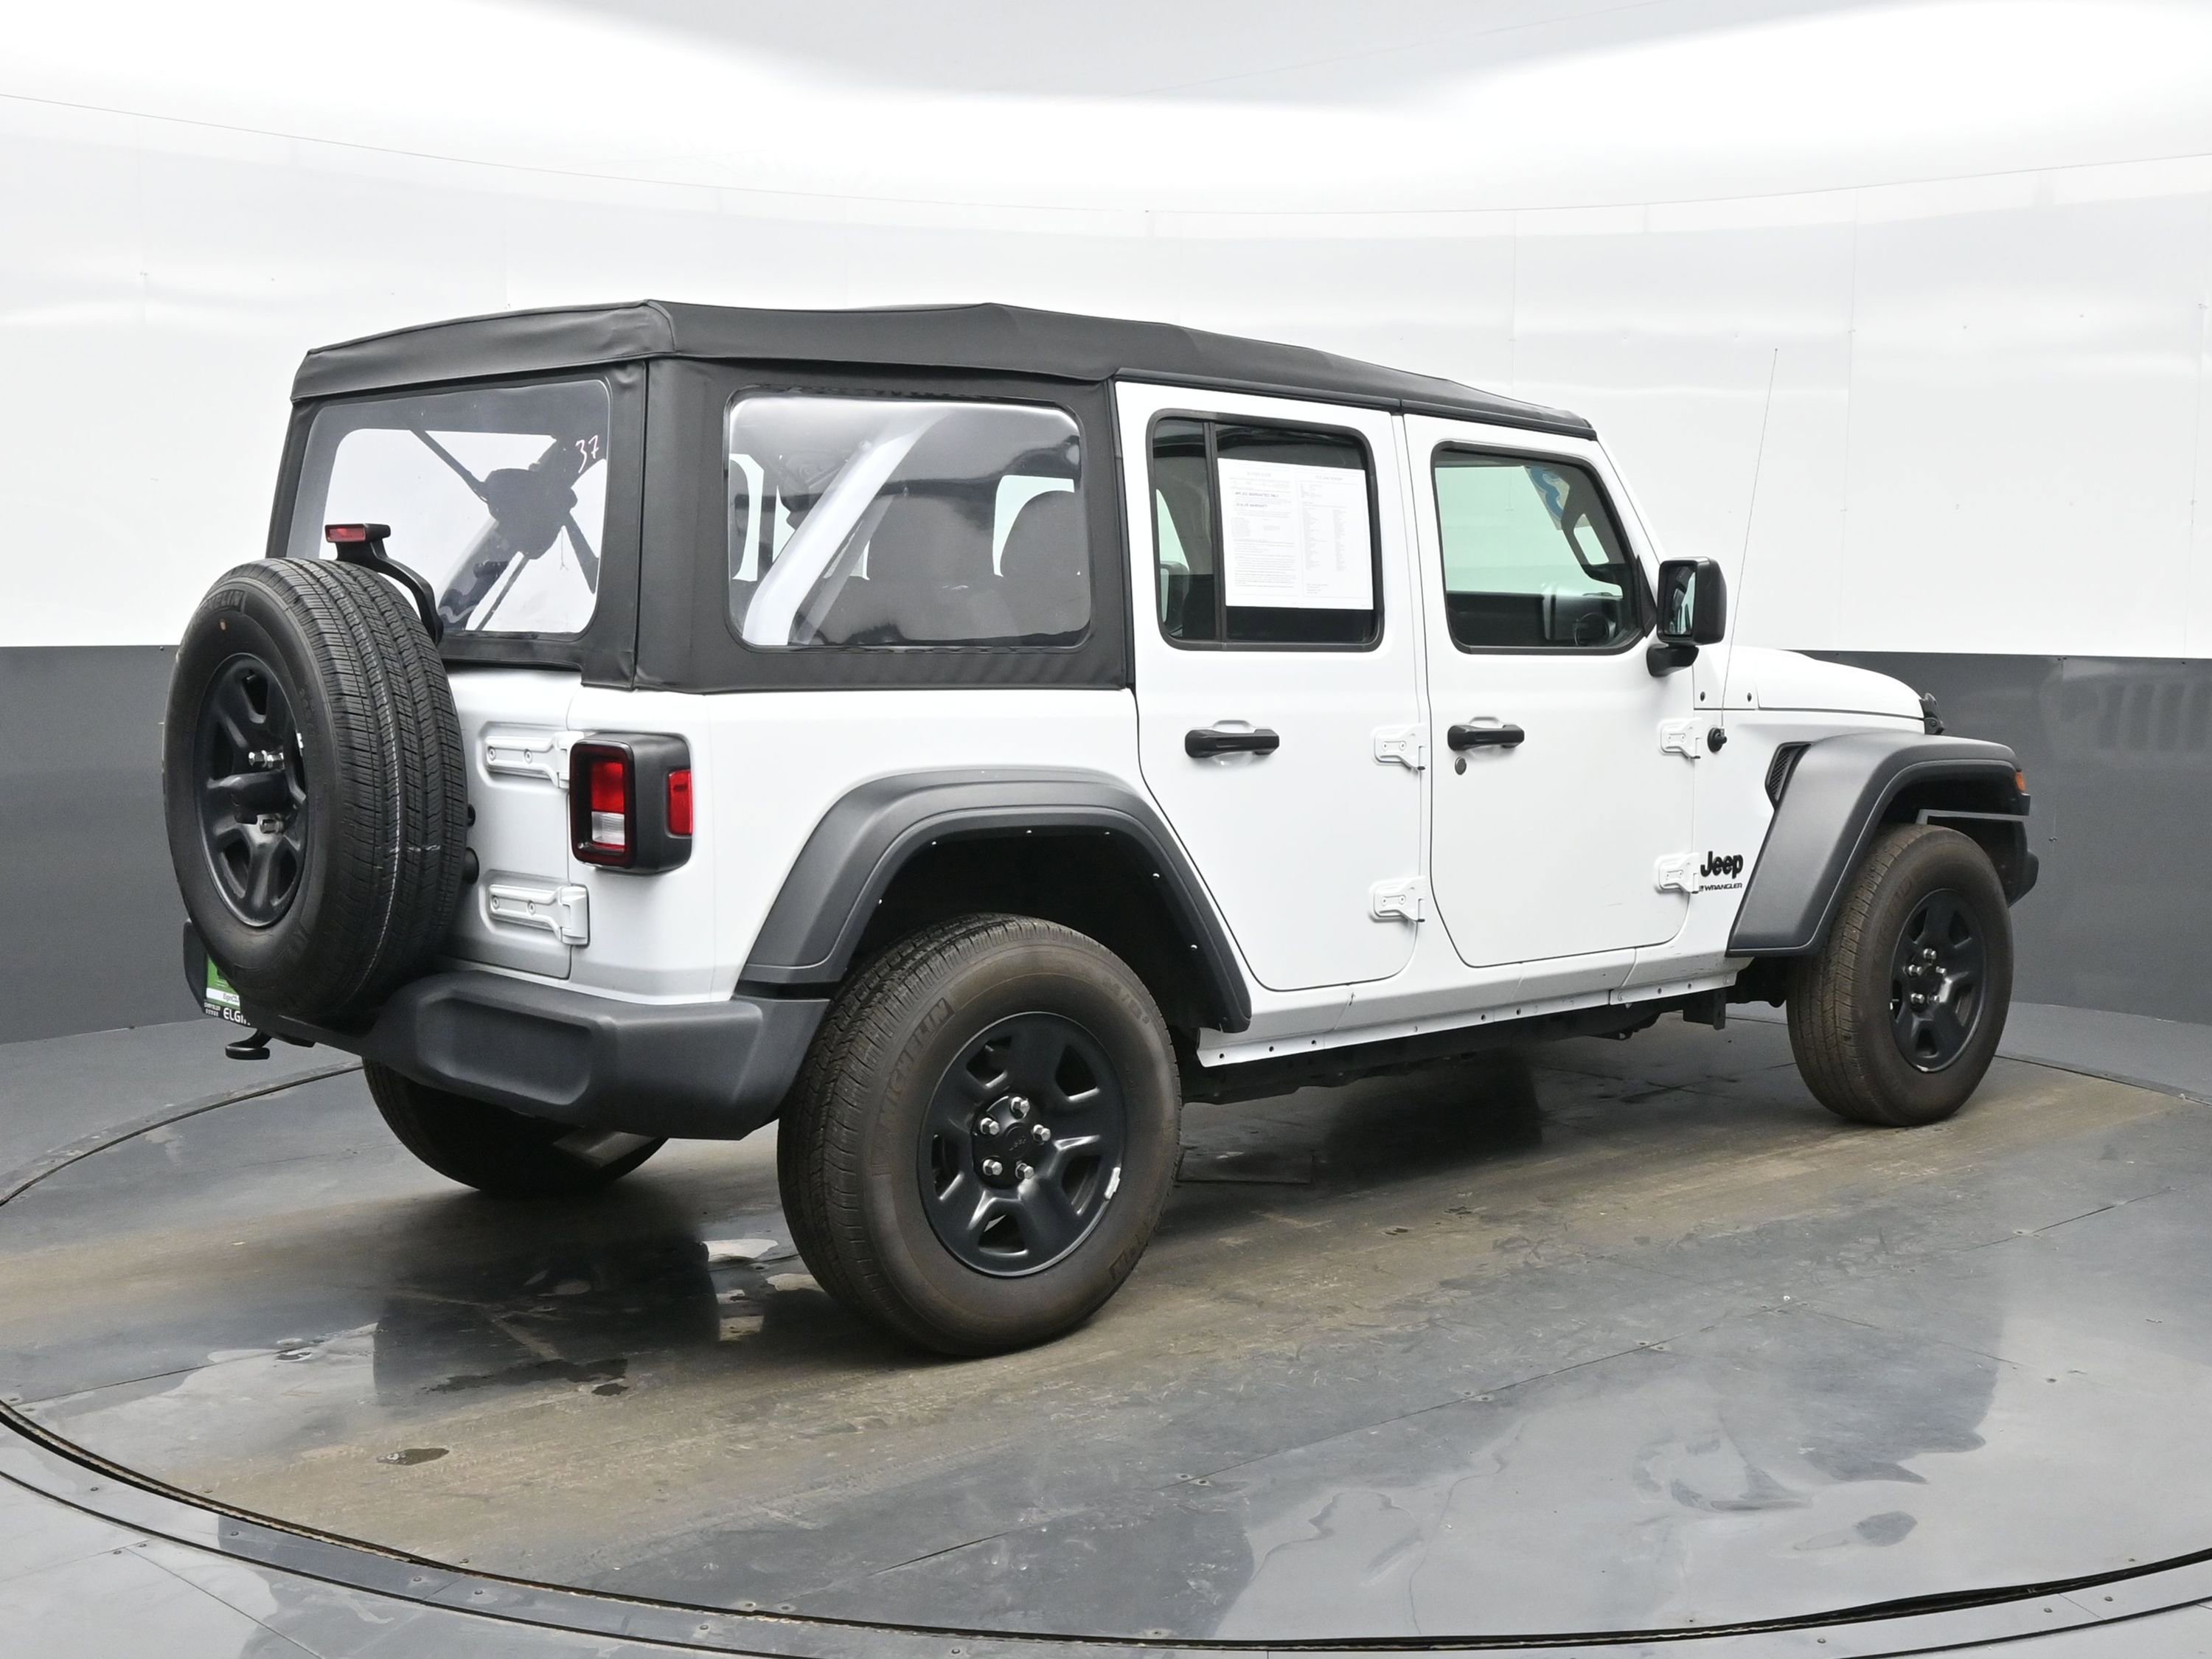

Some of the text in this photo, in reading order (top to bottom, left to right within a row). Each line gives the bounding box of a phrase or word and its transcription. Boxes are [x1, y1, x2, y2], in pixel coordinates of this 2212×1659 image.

[575, 434, 599, 473] 37
[1700, 850, 1743, 879] Jeep
[1705, 883, 1742, 891] WRANGLER
